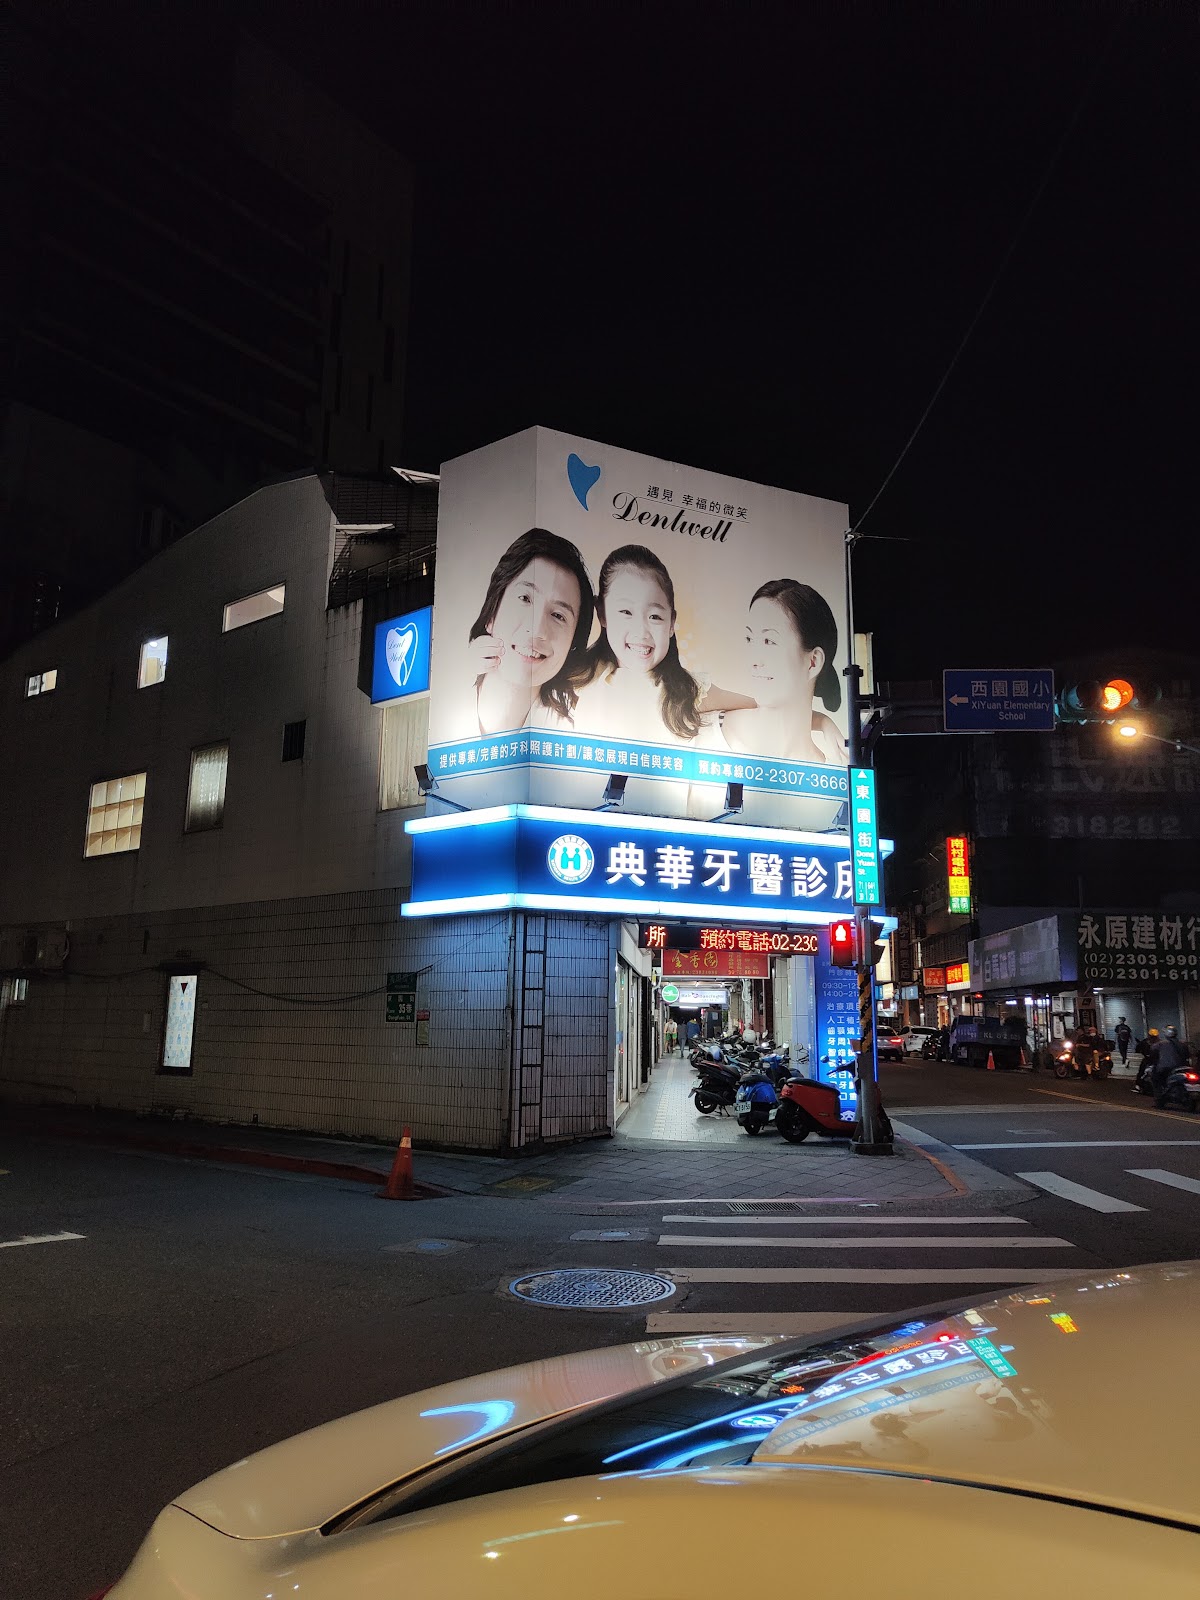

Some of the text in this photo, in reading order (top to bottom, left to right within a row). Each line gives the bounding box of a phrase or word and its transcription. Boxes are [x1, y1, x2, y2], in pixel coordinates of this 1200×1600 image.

[647, 485, 748, 520] 遇見 幸福的微笑
[612, 491, 733, 543] Dentwell
[970, 680, 1050, 697] 西園國小
[1004, 701, 1050, 712] Elementary
[999, 712, 1026, 721] School
[855, 784, 873, 848] 東園街
[855, 850, 875, 860] Dong
[857, 859, 876, 867] Yuan
